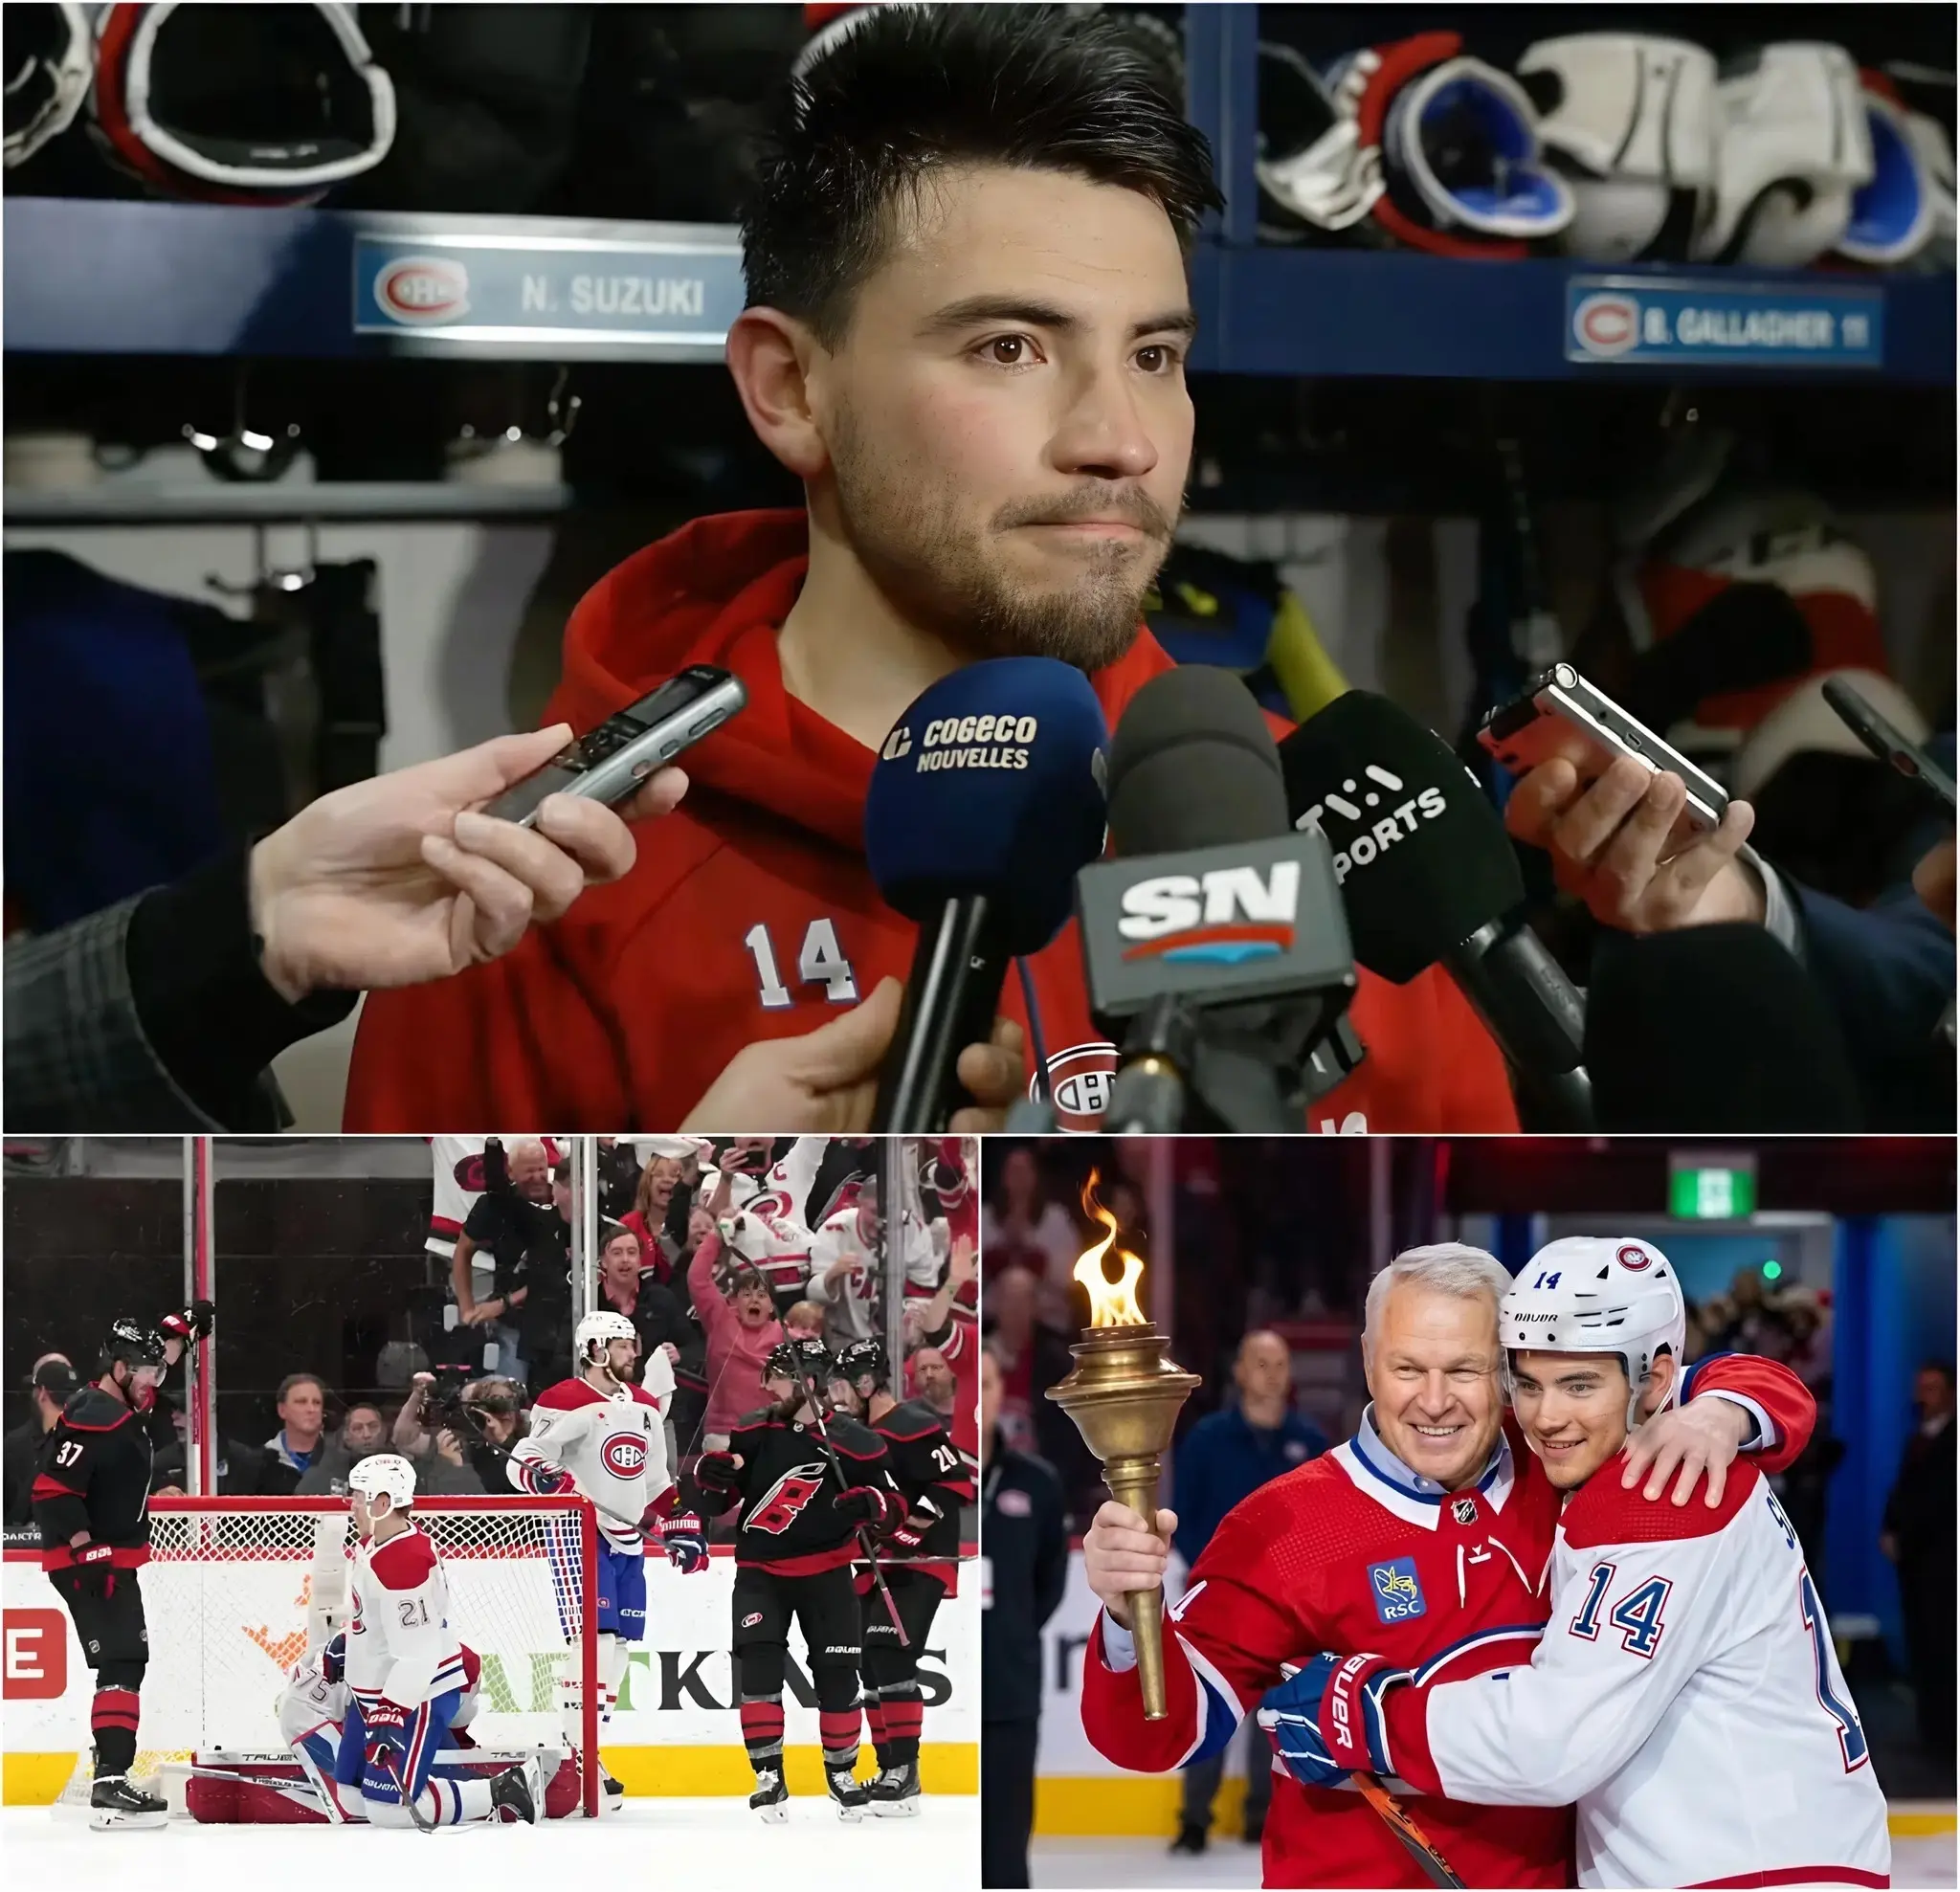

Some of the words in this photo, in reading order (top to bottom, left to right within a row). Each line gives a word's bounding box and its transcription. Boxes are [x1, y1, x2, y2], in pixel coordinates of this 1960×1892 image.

[522, 274, 556, 313] N.
[569, 277, 704, 316] SUZUKI
[1677, 307, 1832, 347] GALLAGHER
[916, 747, 1029, 773] NOUVELLES
[1118, 860, 1300, 940] SN
[744, 917, 859, 1007] 14
[1533, 1271, 1563, 1289] 14
[56, 1440, 84, 1467] 37
[397, 1596, 432, 1629] 21
[1384, 1599, 1421, 1620] RSC
[1569, 1562, 1673, 1659] 14
[6, 1628, 45, 1680] E
